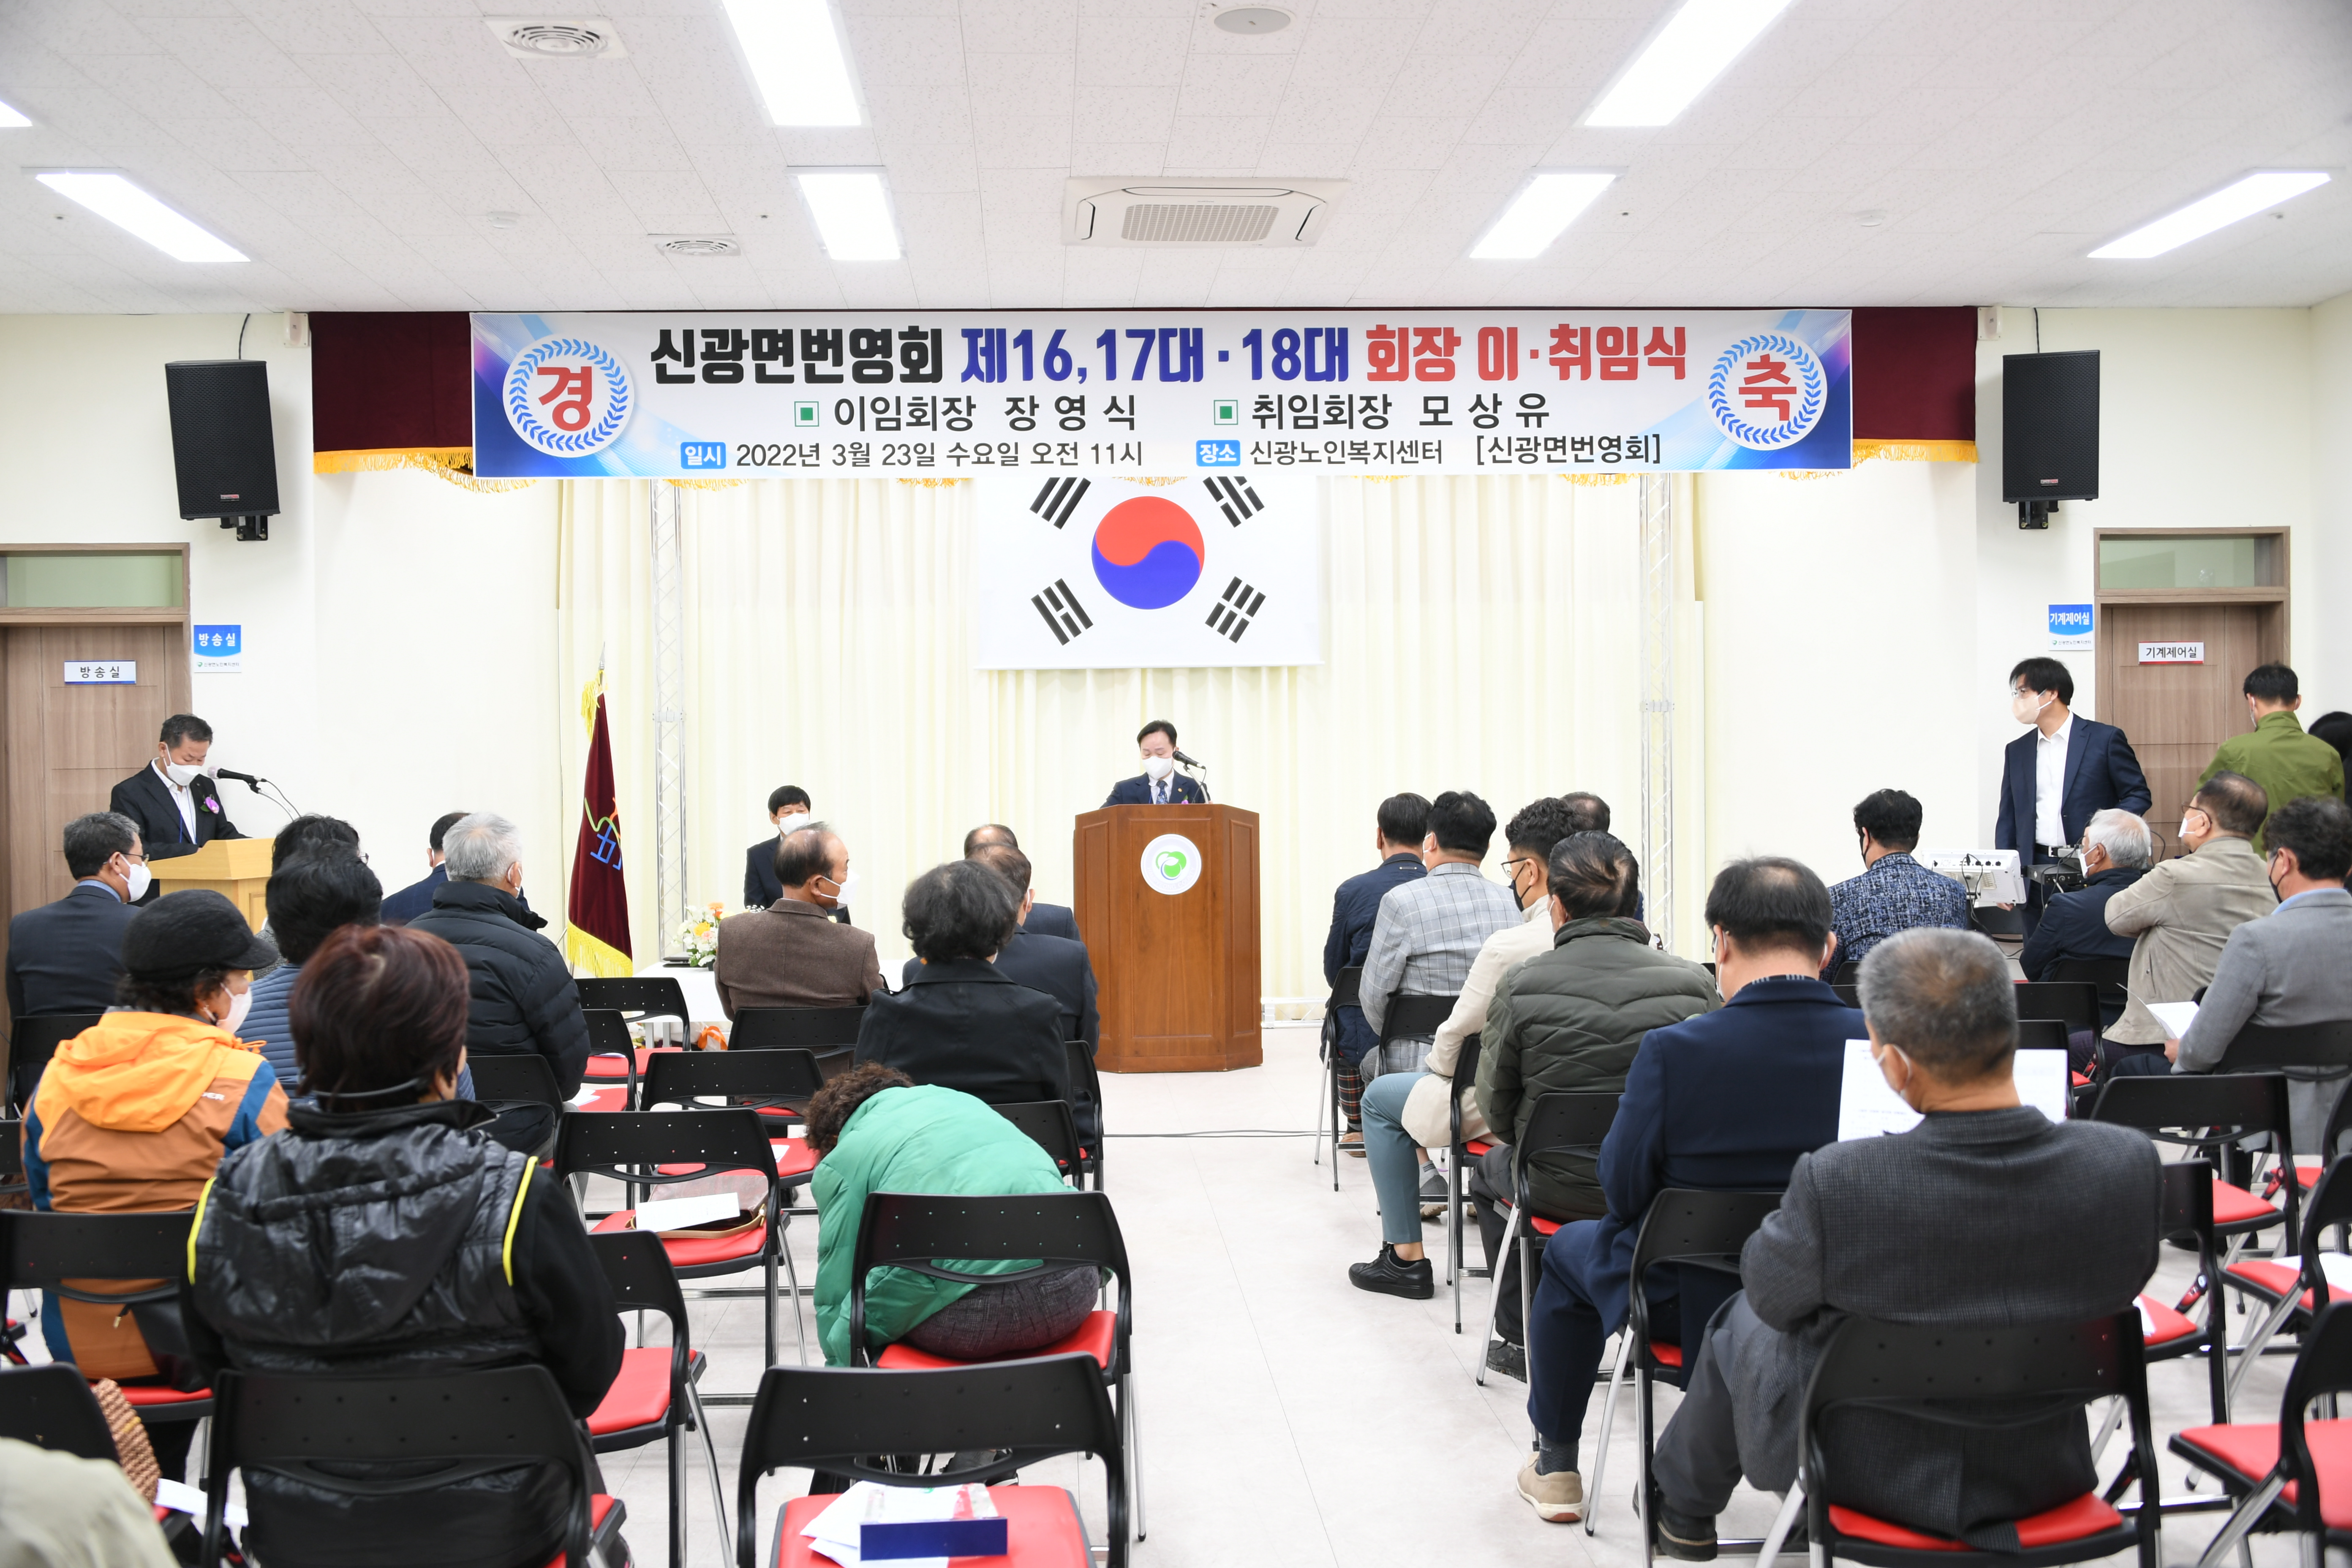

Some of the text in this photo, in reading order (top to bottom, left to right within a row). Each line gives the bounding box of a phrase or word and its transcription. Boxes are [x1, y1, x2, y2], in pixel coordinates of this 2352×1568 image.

[651, 326, 943, 384] 신광면번영회
[1366, 324, 1461, 382] 회장
[537, 366, 592, 431] 경
[1739, 354, 1797, 421] 축
[834, 396, 976, 432] 이임회장
[1252, 394, 1392, 430] 취임회장
[685, 442, 1141, 468] 일시 2022년 3월 23일 수요일 오전 11시
[1200, 434, 1660, 466] 장소 신광노인복지센터 [신광면번영회]
[2050, 612, 2089, 625] 기계제어실
[2146, 647, 2197, 659] 기계제어실
